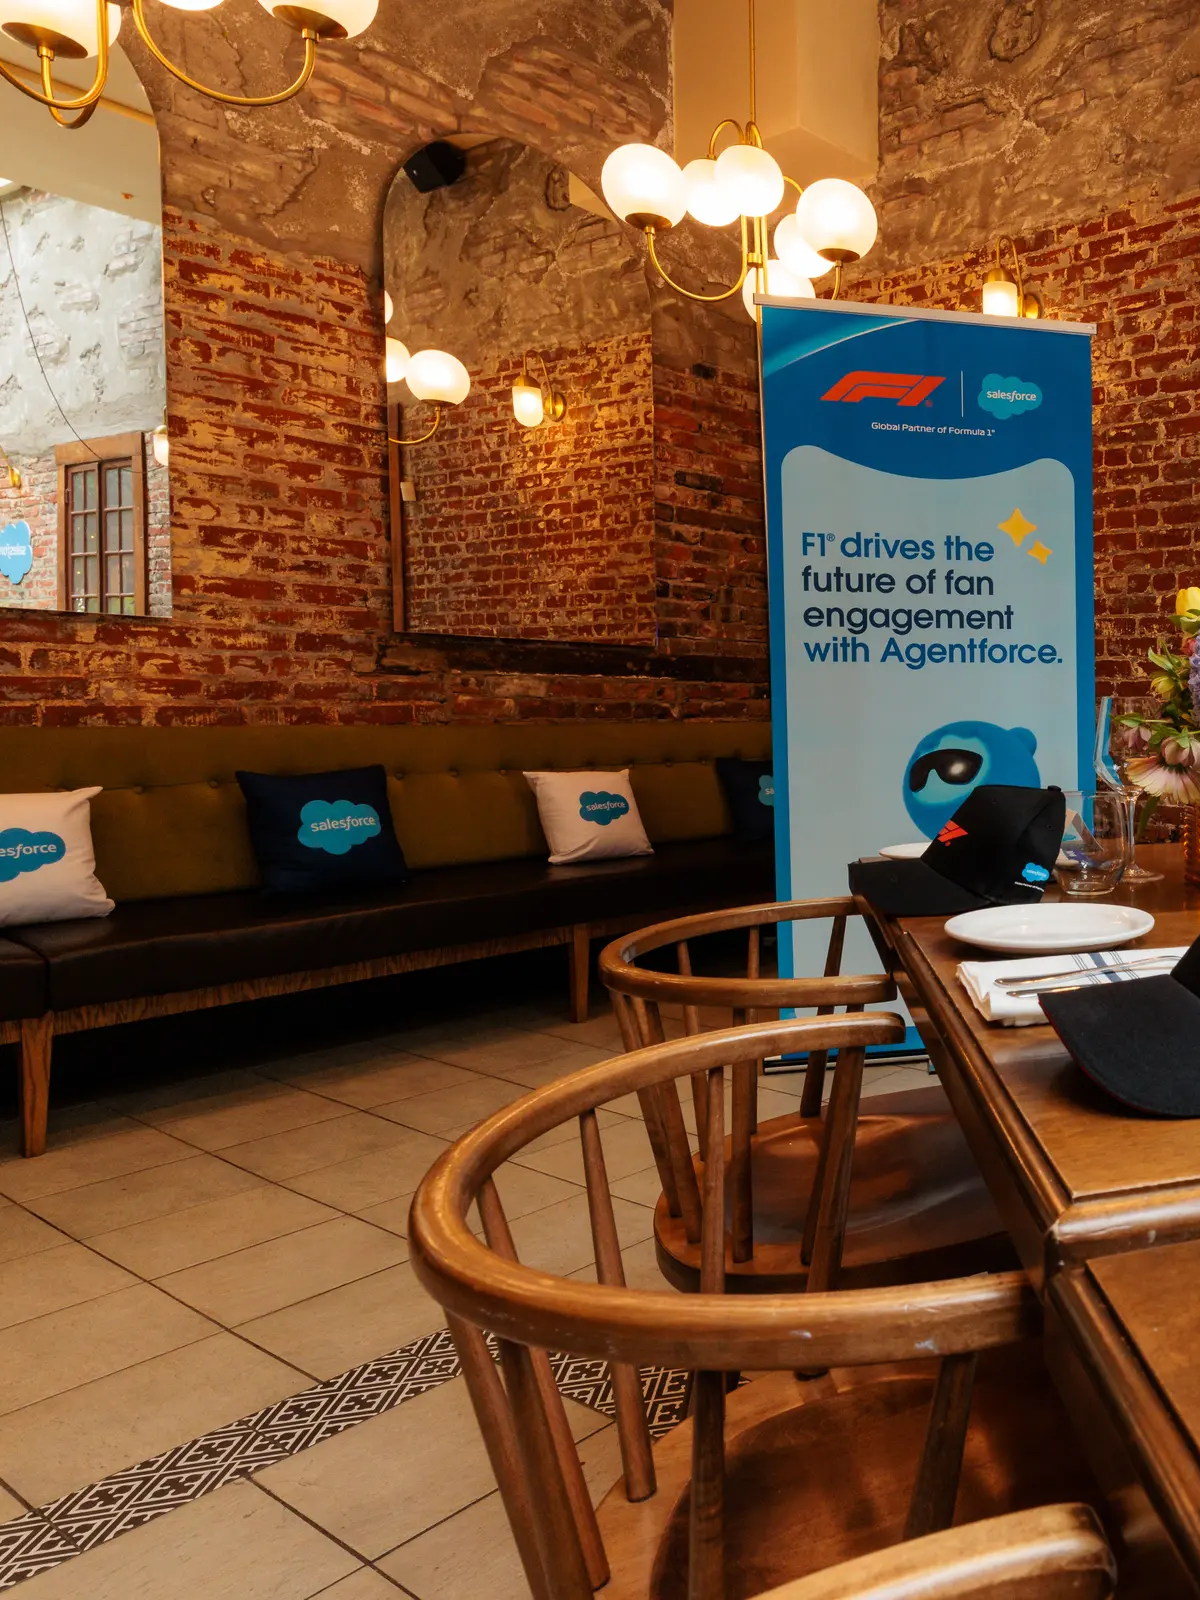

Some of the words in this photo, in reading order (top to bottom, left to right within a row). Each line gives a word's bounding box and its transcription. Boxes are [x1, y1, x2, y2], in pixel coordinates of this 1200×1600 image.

[986, 389, 1037, 403] salesforce
[871, 421, 900, 431] Global
[902, 424, 935, 433] Partner
[937, 426, 947, 434] of
[948, 427, 986, 436] Formula
[840, 531, 935, 561] drives
[944, 535, 995, 562] the
[801, 565, 896, 594] future
[905, 568, 936, 595] of
[944, 569, 994, 595] fan
[803, 605, 1014, 636] engagement
[803, 636, 870, 663] with
[880, 637, 1063, 670] Agentforce.
[585, 800, 626, 812] salesforce
[310, 815, 377, 833] salesforce
